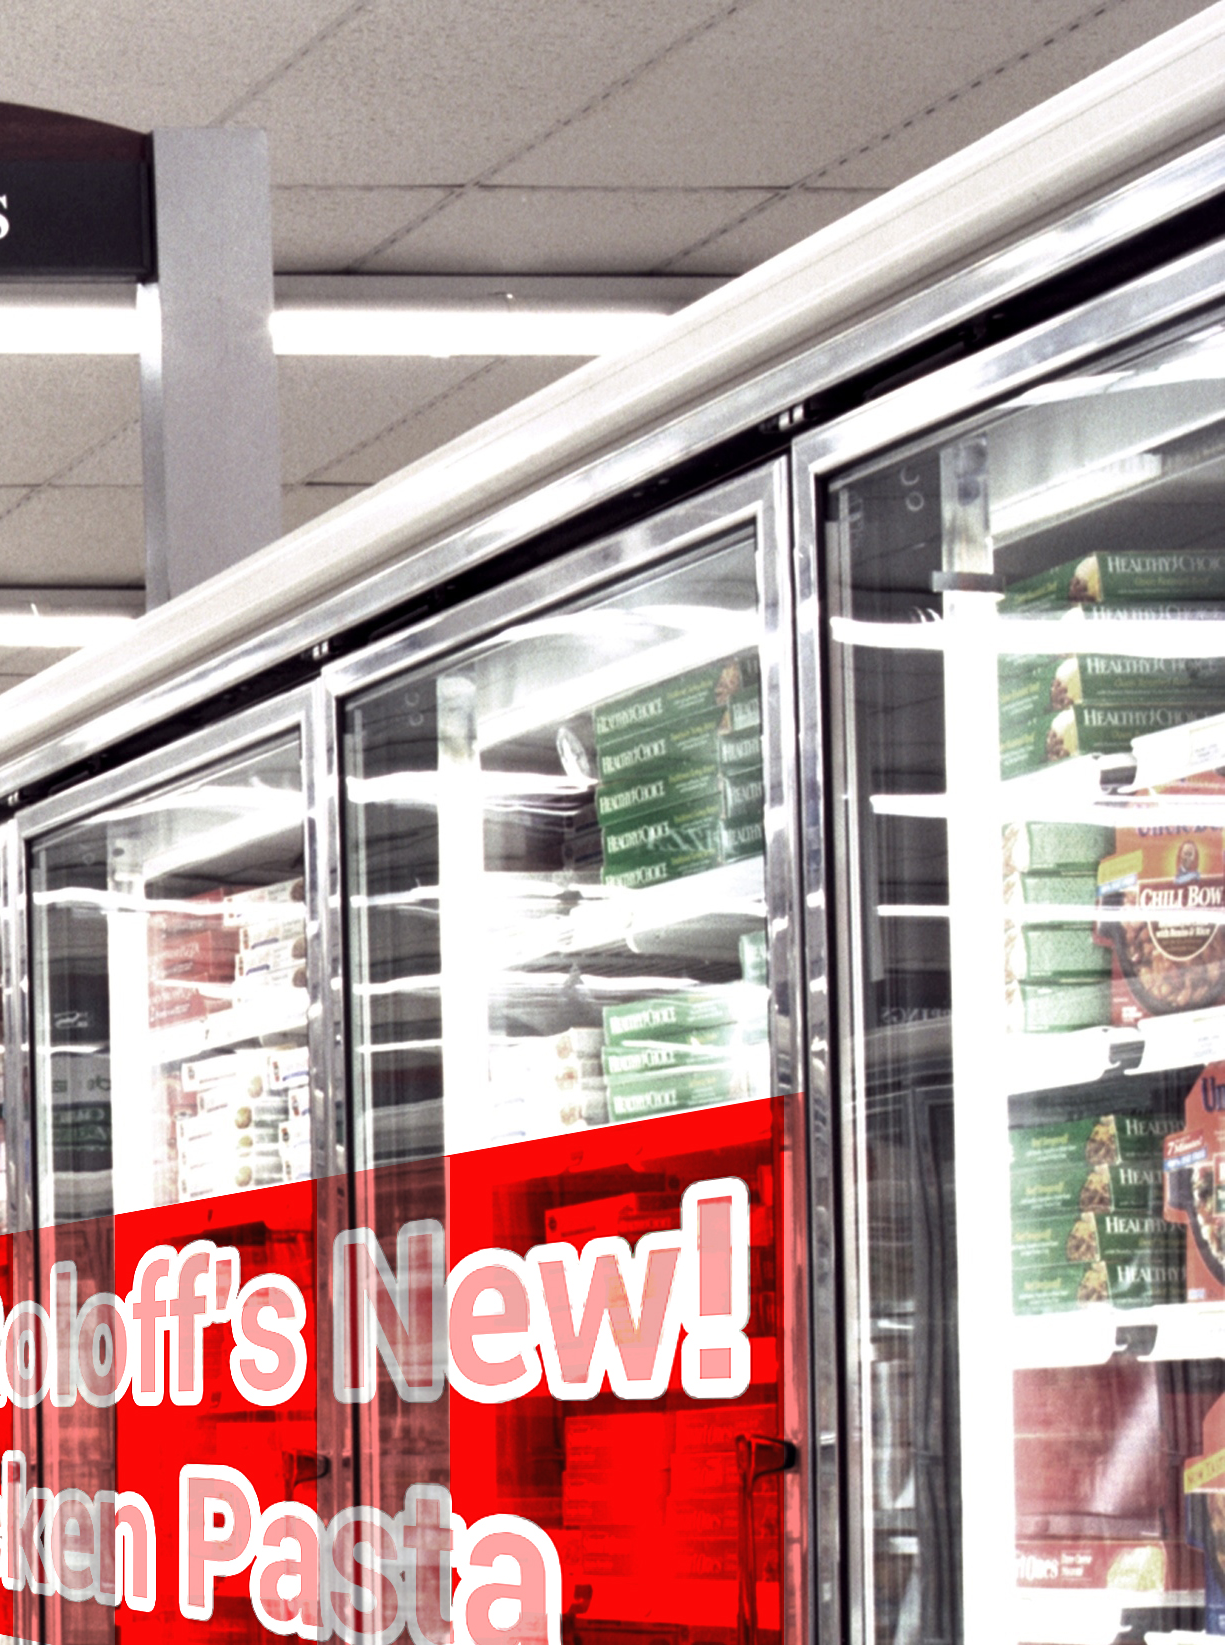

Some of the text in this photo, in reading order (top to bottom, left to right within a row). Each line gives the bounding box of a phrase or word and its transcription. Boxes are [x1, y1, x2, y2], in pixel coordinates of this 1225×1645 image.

[1107, 555, 1172, 573] HEALTHY
[1086, 657, 1152, 674] HEALTHY
[1083, 708, 1150, 726] HEALTHY
